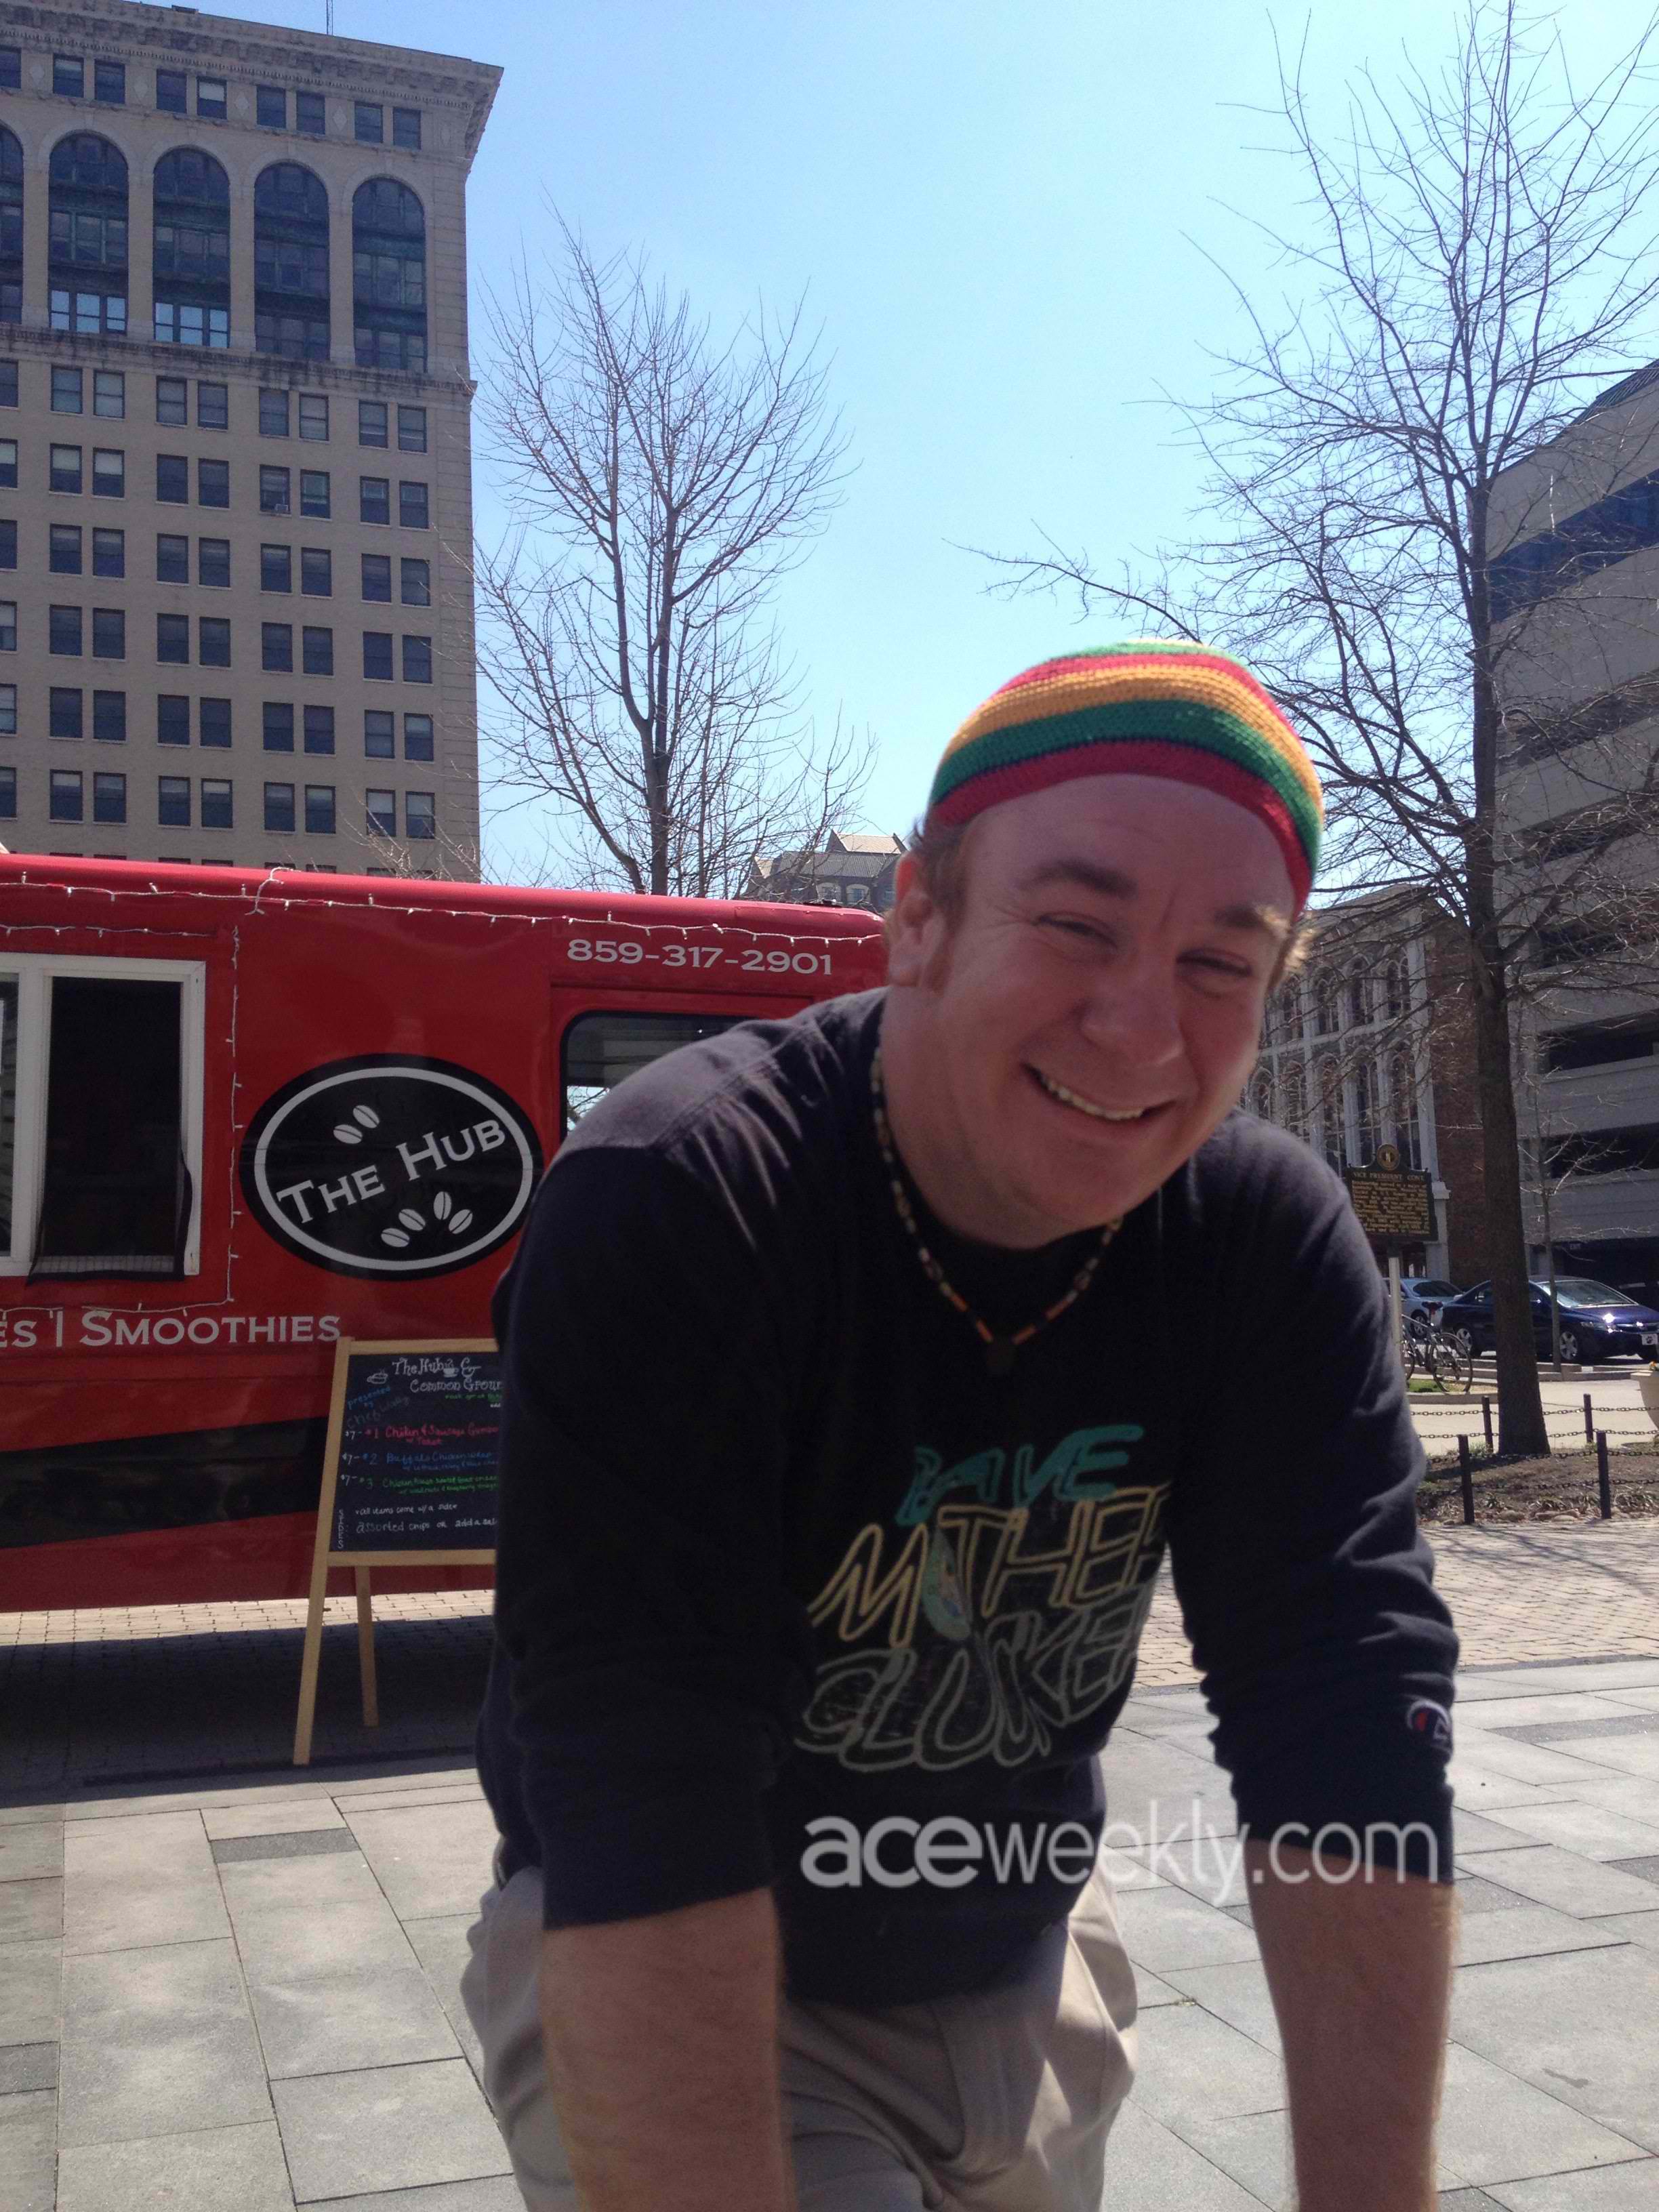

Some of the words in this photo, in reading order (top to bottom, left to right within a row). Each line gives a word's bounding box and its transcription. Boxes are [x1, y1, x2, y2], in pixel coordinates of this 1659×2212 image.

[567, 939, 832, 975] 859-317-2901
[392, 1357, 417, 1376] The
[418, 1357, 445, 1375] Hub
[409, 1379, 461, 1393] Common
[356, 1520, 405, 1534] assorted
